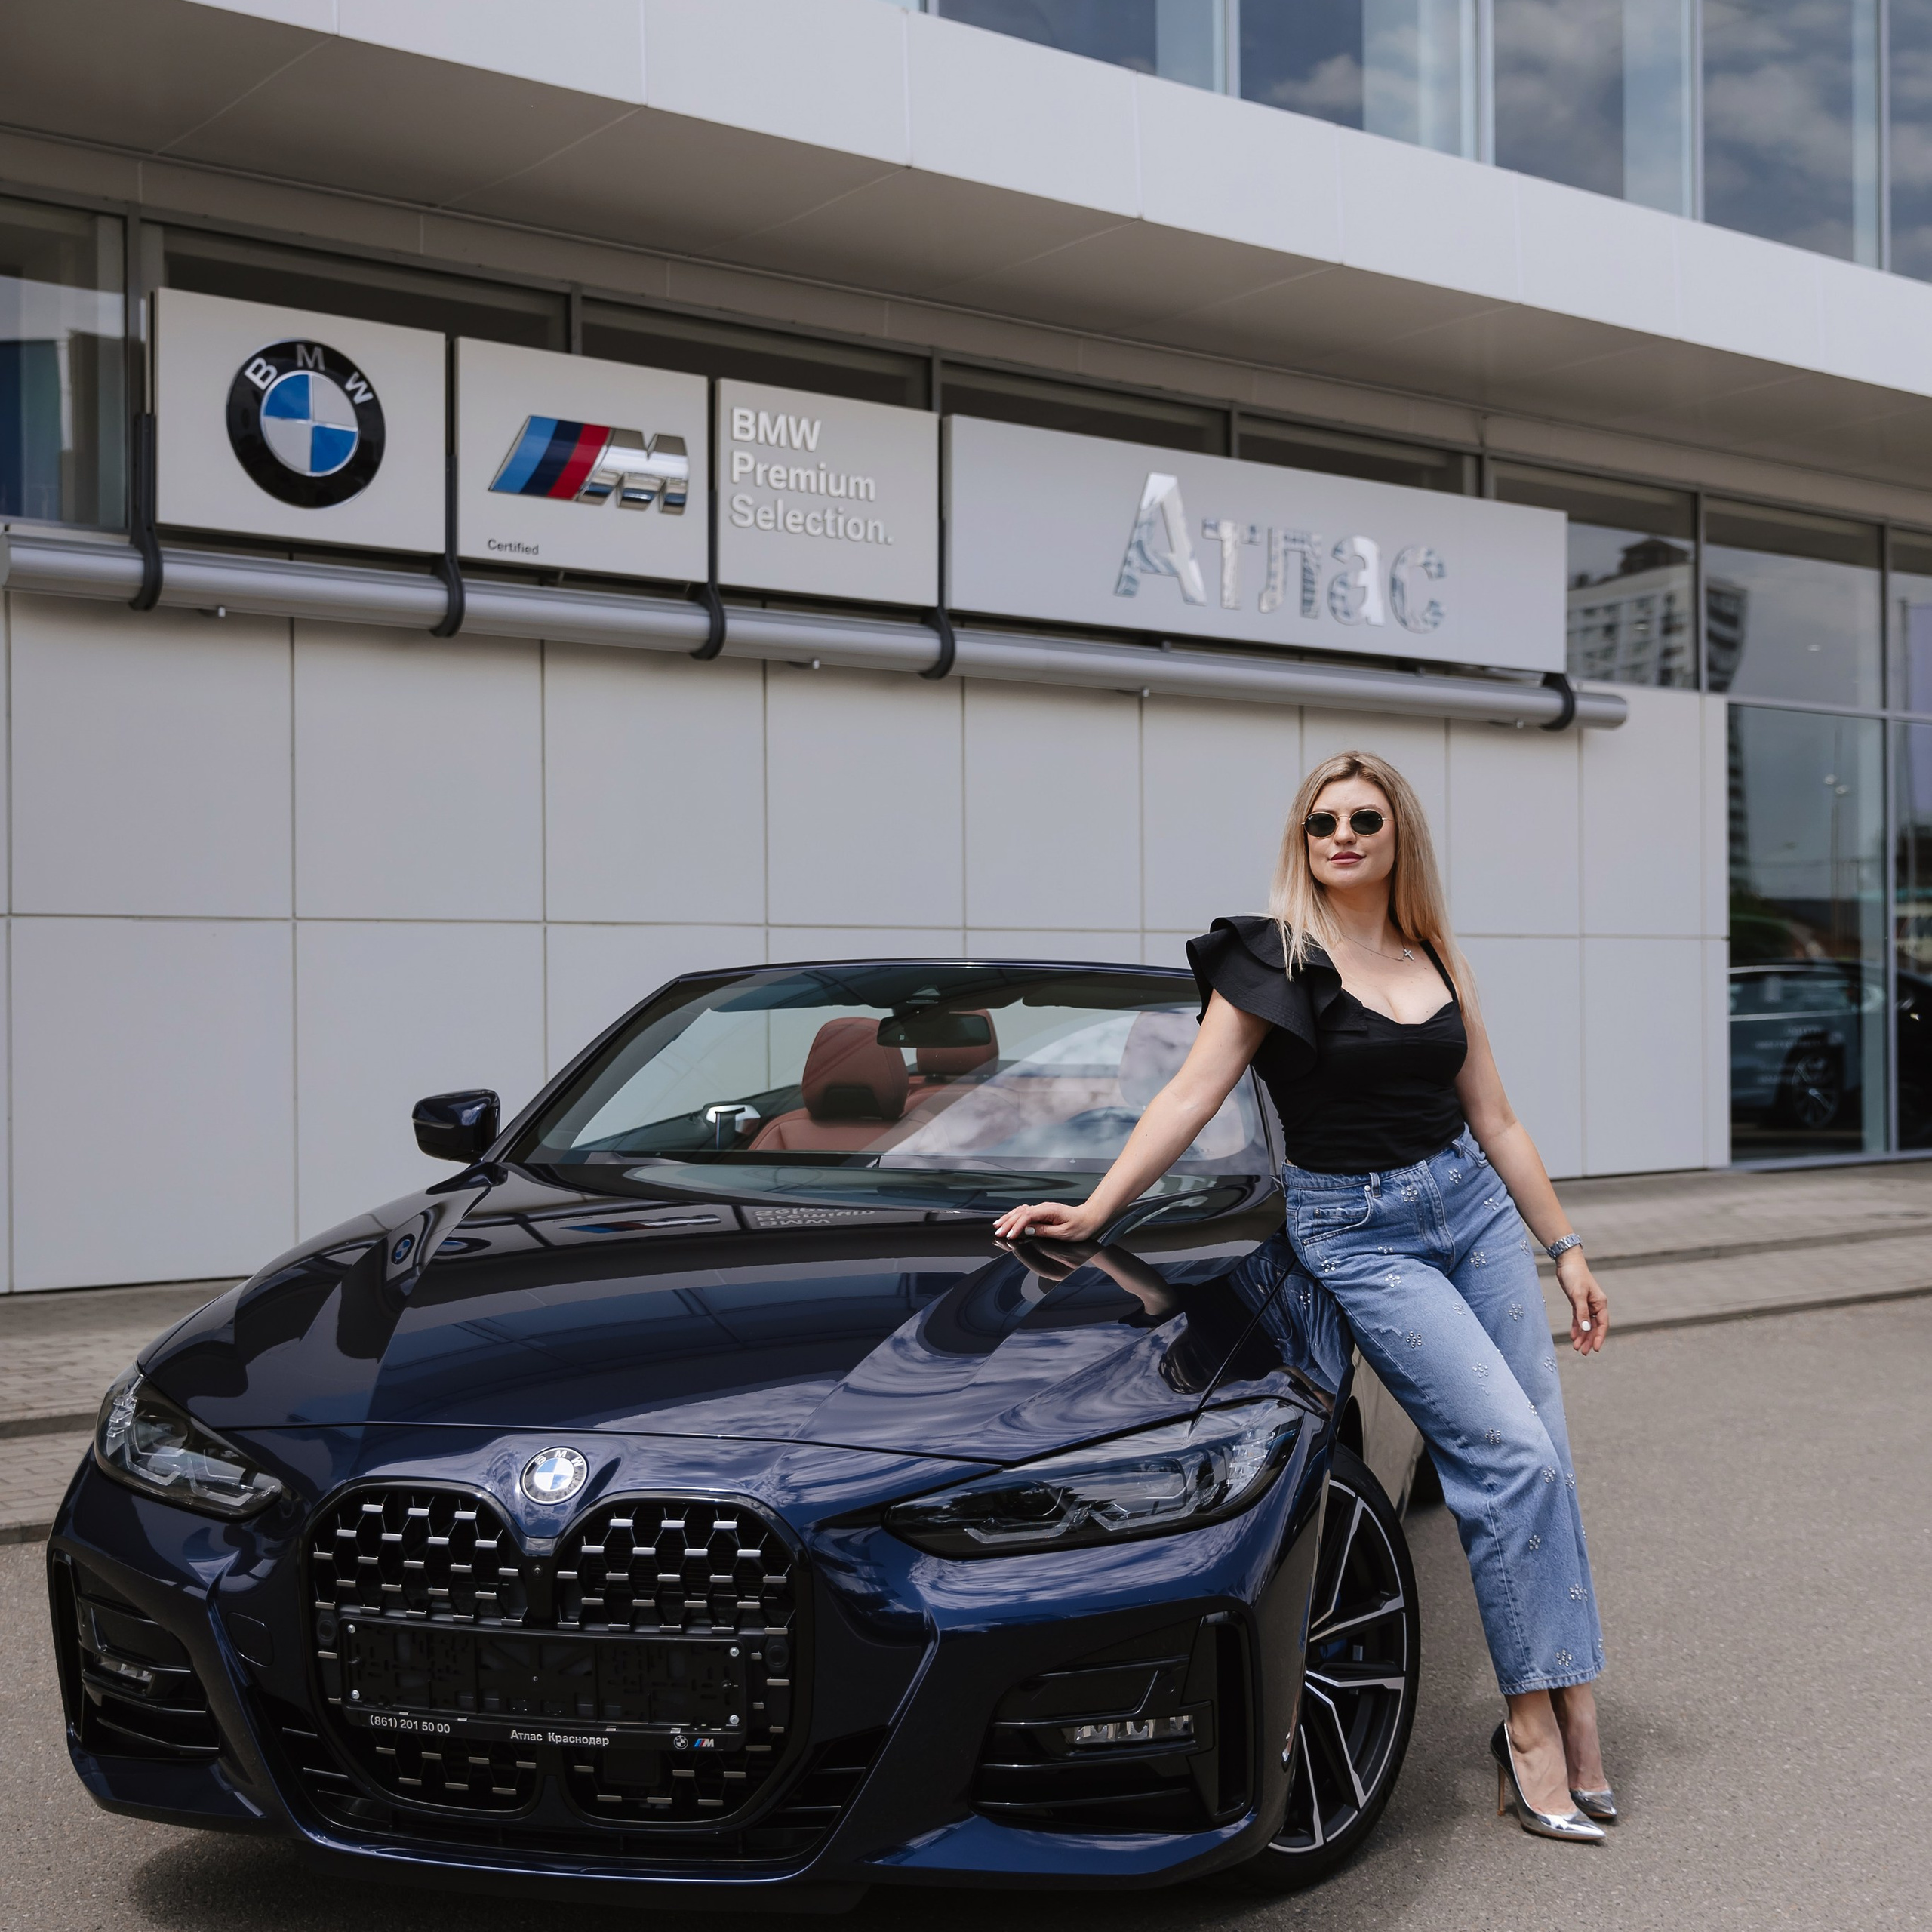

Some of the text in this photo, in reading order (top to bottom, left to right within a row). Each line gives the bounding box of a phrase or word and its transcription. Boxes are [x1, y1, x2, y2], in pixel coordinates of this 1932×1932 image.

[245, 344, 373, 405] BMW
[731, 407, 822, 451] BMW
[731, 451, 875, 502] Premium
[730, 494, 894, 545] Selection.
[488, 539, 539, 555] Certified
[1114, 472, 1446, 634] Атлас
[534, 1450, 584, 1467] BMW
[370, 1715, 451, 1734] (861) 201 50 00
[510, 1730, 610, 1747] Атлас Краснодар
